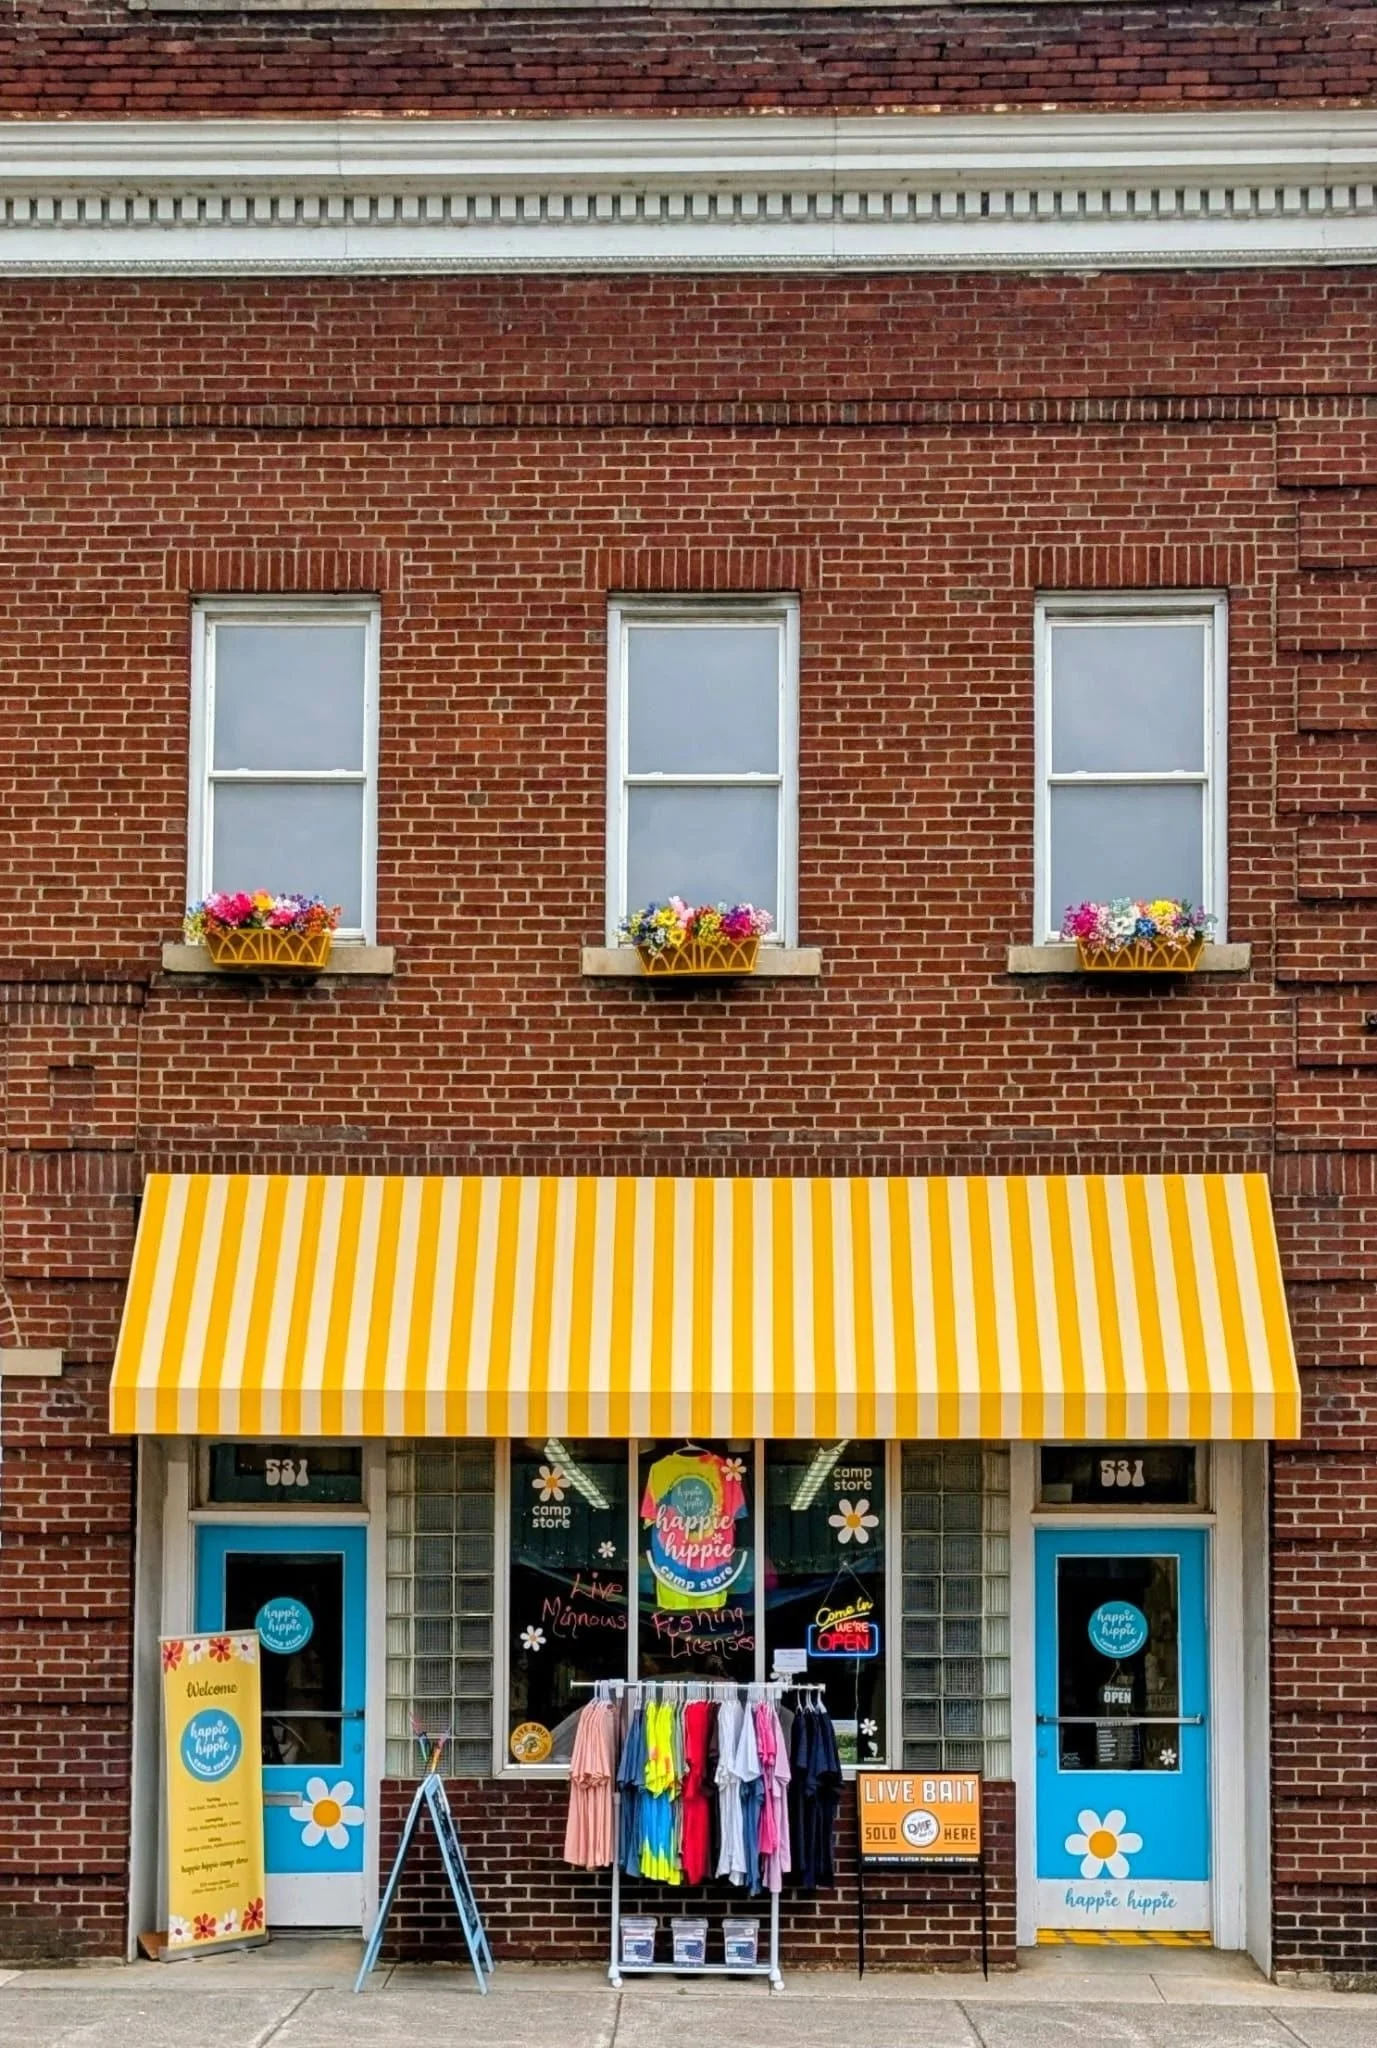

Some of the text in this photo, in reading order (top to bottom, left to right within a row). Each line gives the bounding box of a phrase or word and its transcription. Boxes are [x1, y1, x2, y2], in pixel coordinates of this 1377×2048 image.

[265, 1459, 309, 1486] 531
[833, 1468, 872, 1481] camp
[1100, 1460, 1145, 1487] 531
[834, 1480, 872, 1490] store
[532, 1505, 571, 1519] camp
[656, 1504, 735, 1540] happie
[532, 1517, 571, 1528] store
[665, 1531, 735, 1568] hippie
[570, 1571, 623, 1602] Live
[660, 1565, 733, 1591] camp store
[264, 1604, 302, 1623] happie
[542, 1596, 627, 1639] Minnows
[651, 1607, 744, 1639] Fishing
[816, 1607, 855, 1627] Come
[1097, 1608, 1136, 1627] happie
[268, 1618, 302, 1636] hippie
[835, 1620, 869, 1632] WE'RE
[1101, 1621, 1137, 1640] hippie
[671, 1636, 756, 1660] Licenses
[817, 1633, 869, 1652] OPEN
[186, 1681, 239, 1698] Welcome
[1103, 1691, 1131, 1704] OPEN
[190, 1719, 229, 1744] happie
[195, 1736, 230, 1759] hippie
[865, 1779, 976, 1804] LIVE BAIT
[865, 1827, 977, 1840] SOLD HERE
[1065, 1887, 1176, 1916] happie hippie
